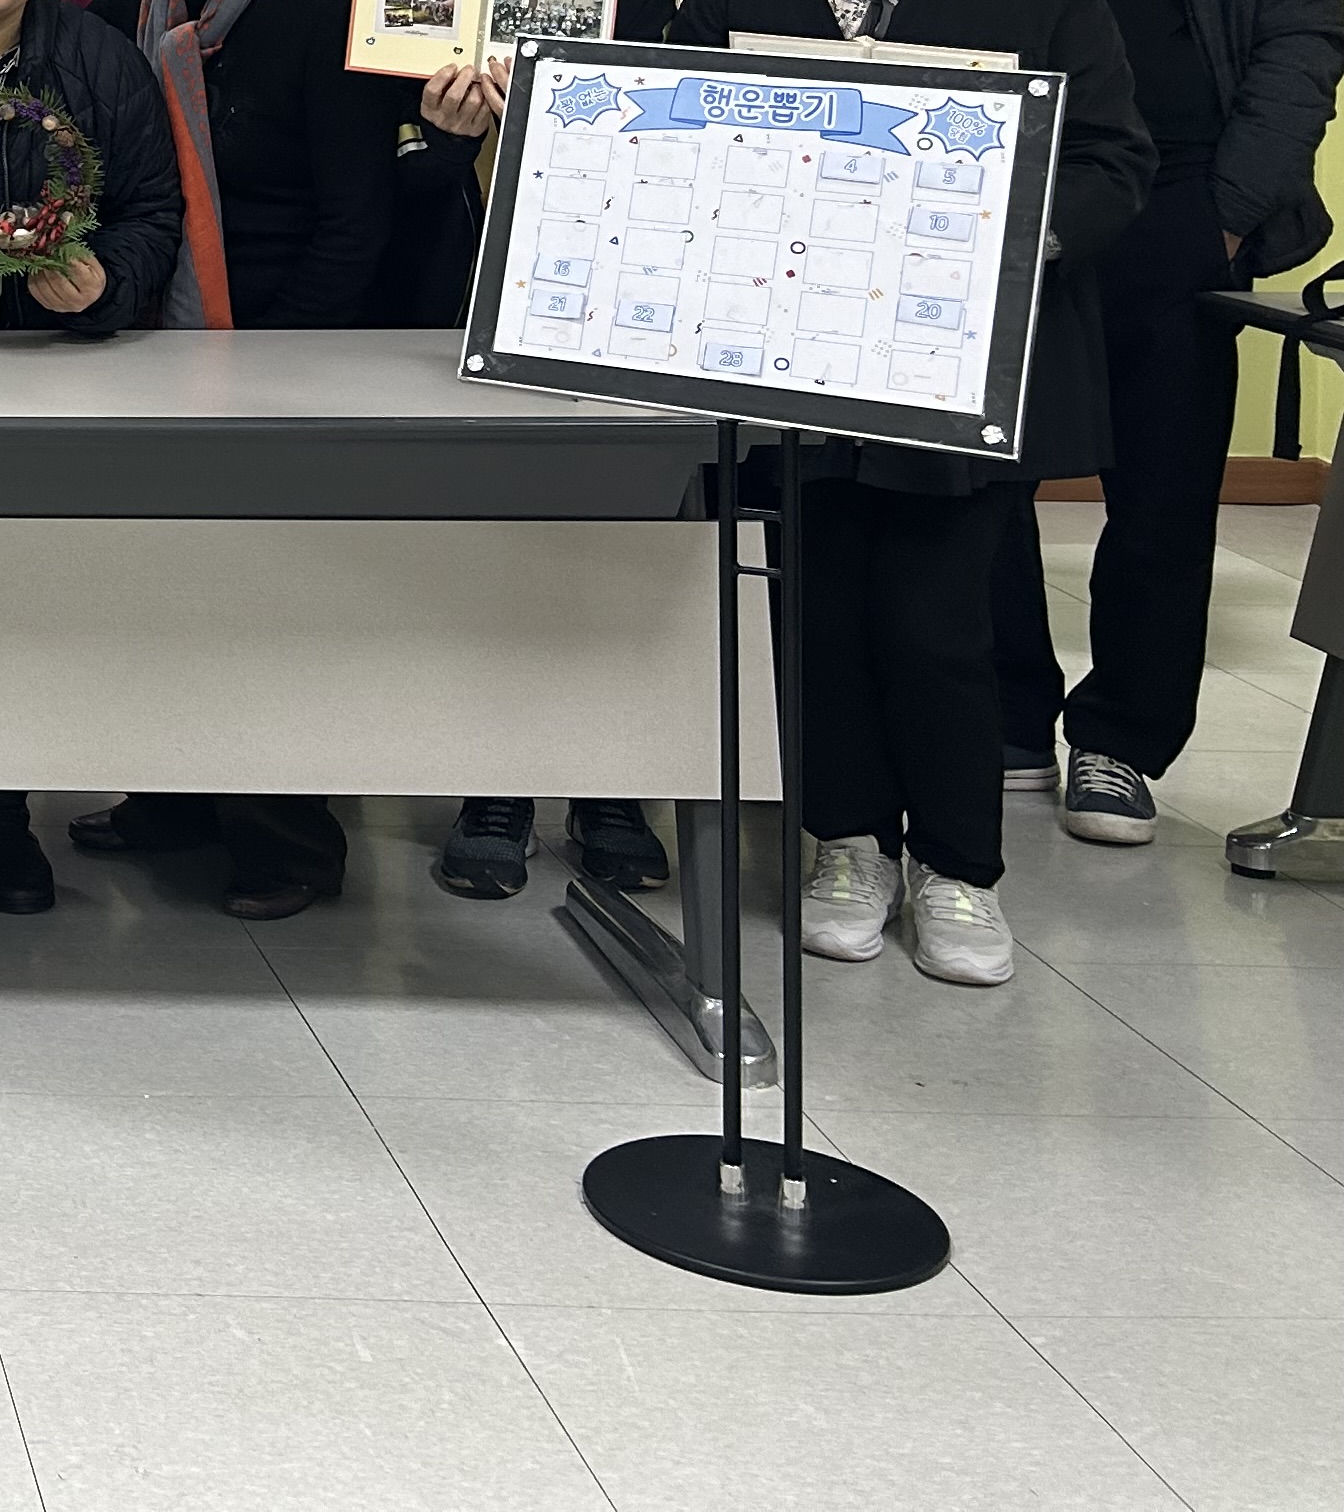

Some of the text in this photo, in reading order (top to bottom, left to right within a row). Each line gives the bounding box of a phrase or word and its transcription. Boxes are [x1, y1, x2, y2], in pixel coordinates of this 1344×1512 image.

[702, 84, 836, 127] 행운뽑기
[948, 110, 986, 136] 100%
[843, 158, 859, 174] 4
[941, 167, 958, 186] 5
[928, 214, 951, 232] 10
[552, 259, 572, 278] 16
[546, 295, 568, 313] 21
[913, 300, 944, 321] 20
[630, 304, 657, 325] 22
[717, 349, 745, 369] 28
